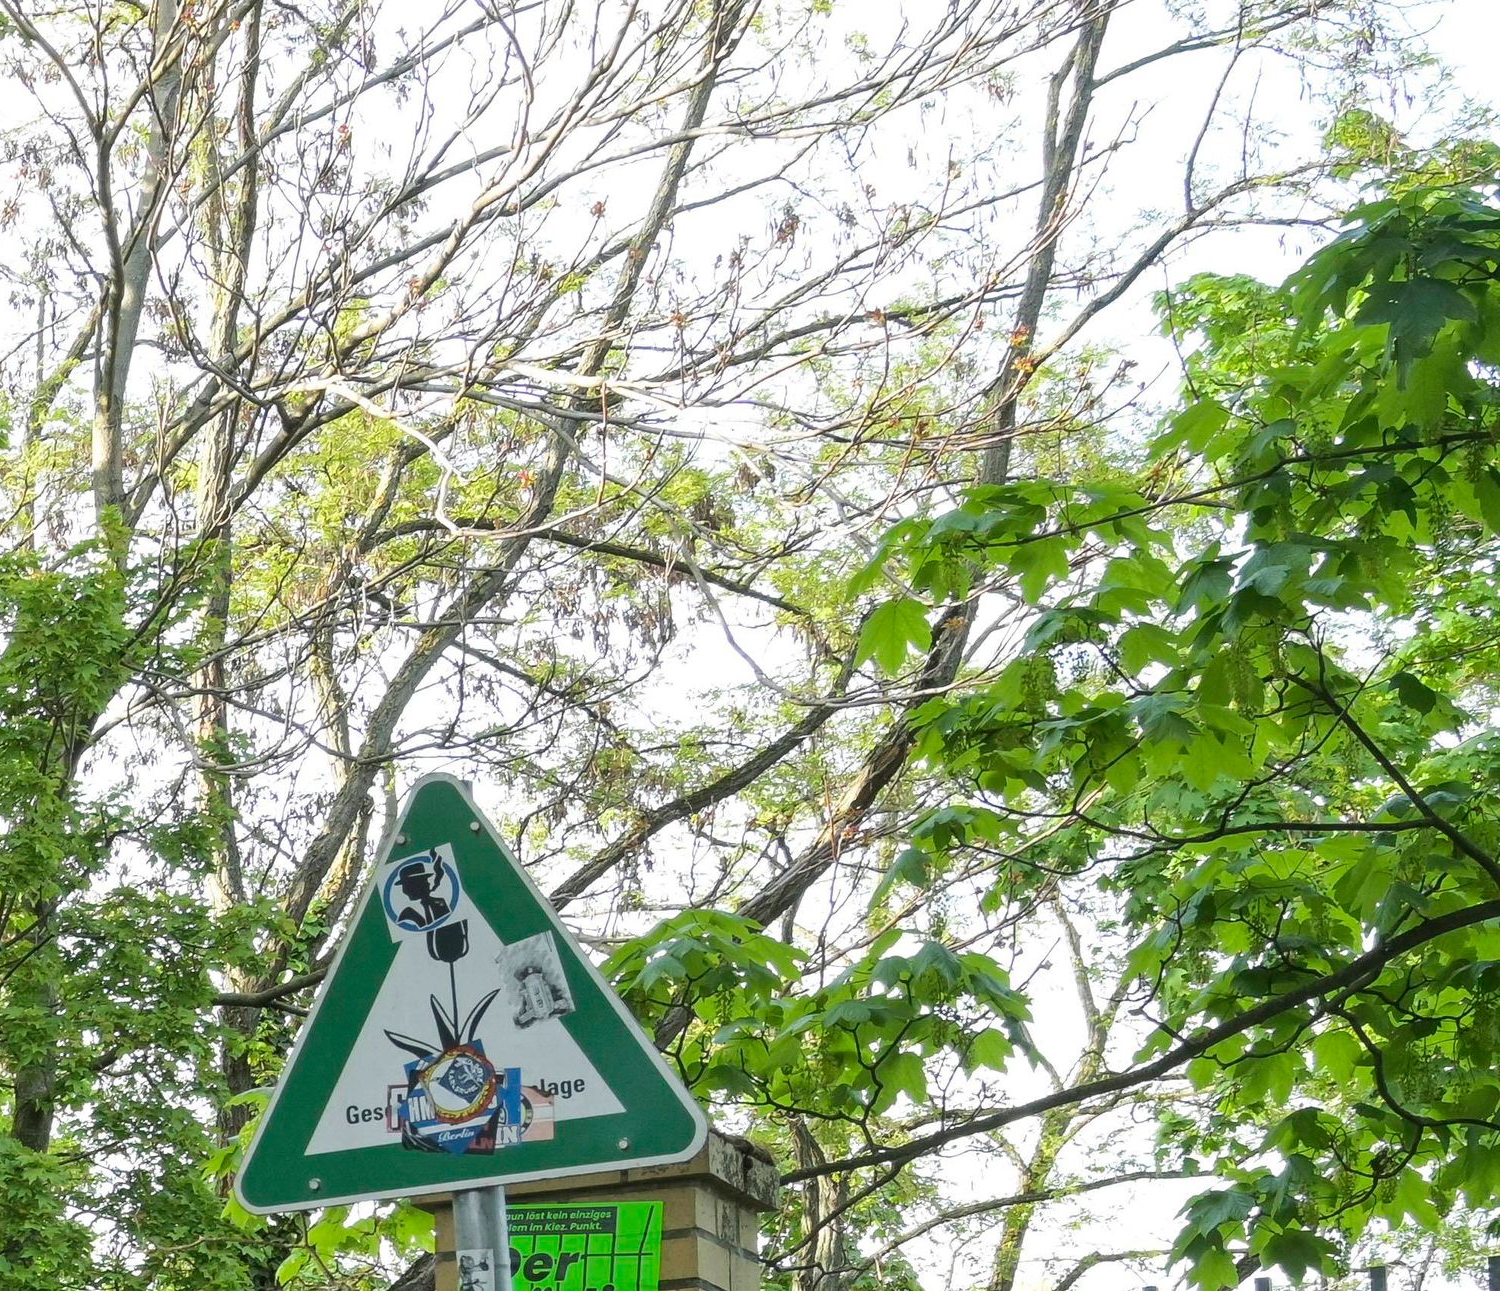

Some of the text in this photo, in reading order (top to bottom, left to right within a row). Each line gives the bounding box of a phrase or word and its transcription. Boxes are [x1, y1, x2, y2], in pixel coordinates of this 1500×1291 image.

[437, 1129, 475, 1145] Berlin
[526, 1211, 545, 1220] löst
[546, 1210, 568, 1220] kein
[570, 1209, 612, 1221] einziges
[529, 1223, 543, 1232] im
[544, 1222, 568, 1232] Kiez.
[569, 1221, 602, 1232] Punkt.
